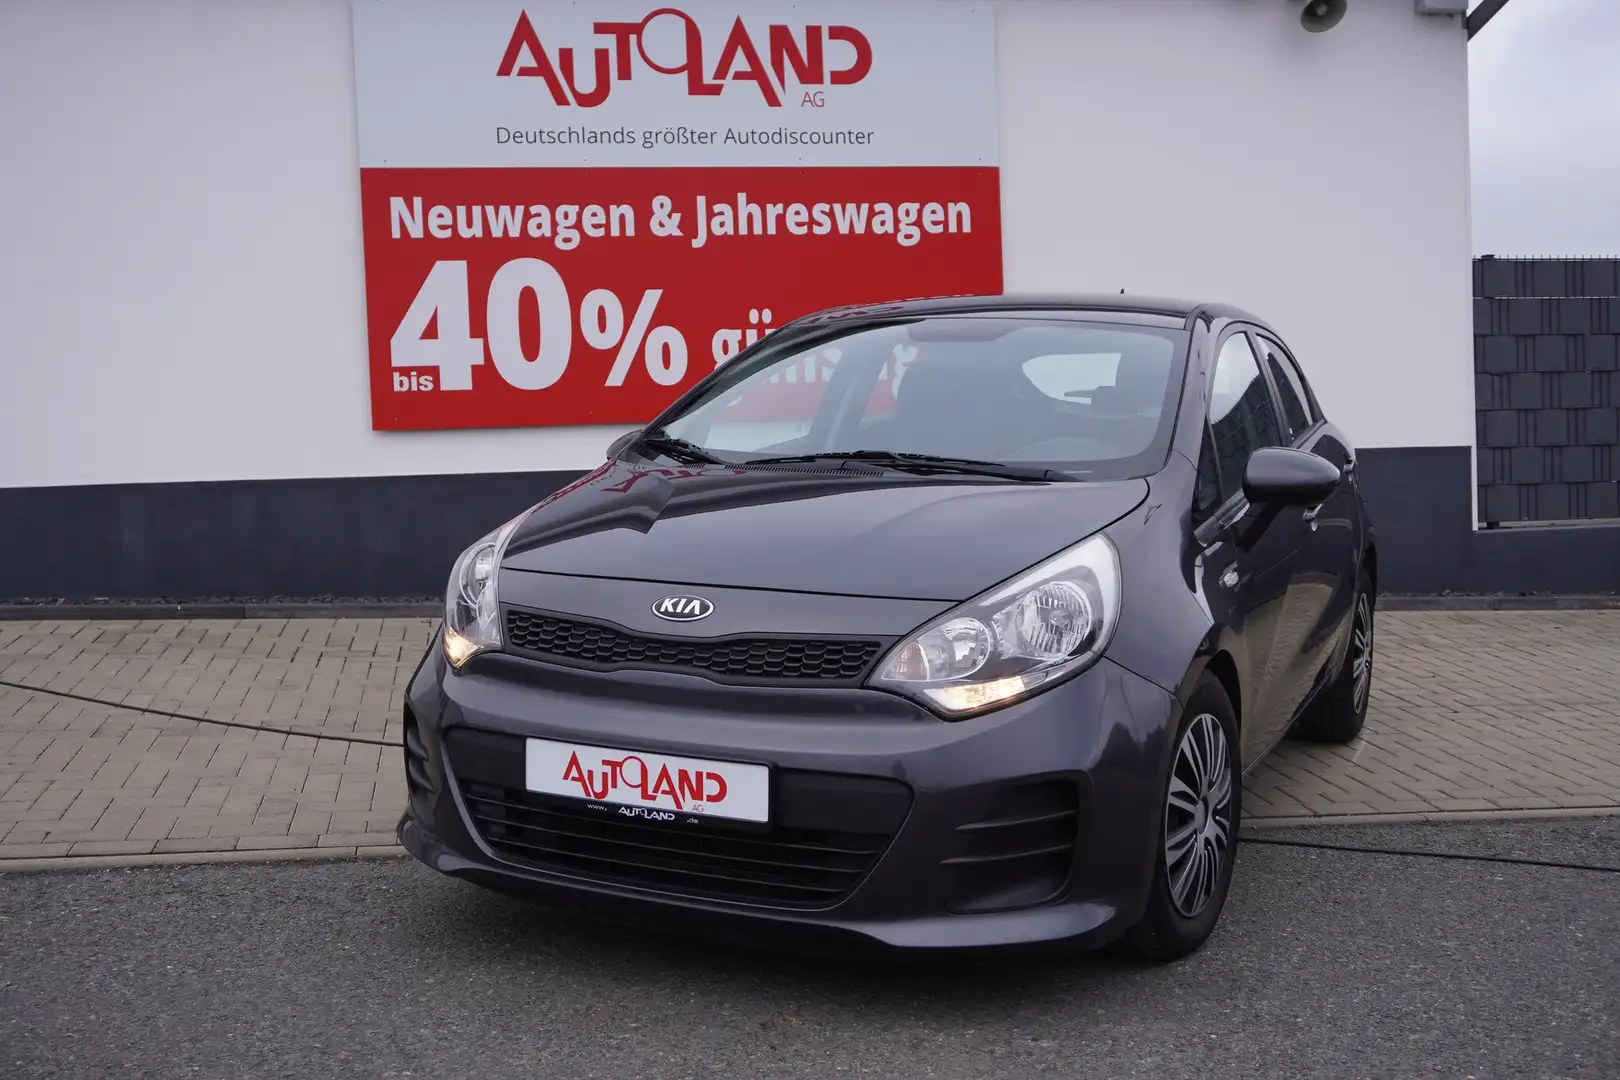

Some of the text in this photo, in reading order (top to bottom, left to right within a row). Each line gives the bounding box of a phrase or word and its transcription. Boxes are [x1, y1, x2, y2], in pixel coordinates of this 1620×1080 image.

[496, 8, 873, 108] AUTOLAND
[801, 91, 826, 108] AG
[496, 126, 875, 149] Deutschlands größter Autodiscounter
[389, 193, 972, 250] Neuwagen & Jahreswagen
[392, 371, 434, 393] bis
[659, 598, 701, 615] KIA
[562, 751, 728, 810] AUTOLAND
[691, 804, 704, 813] AG
